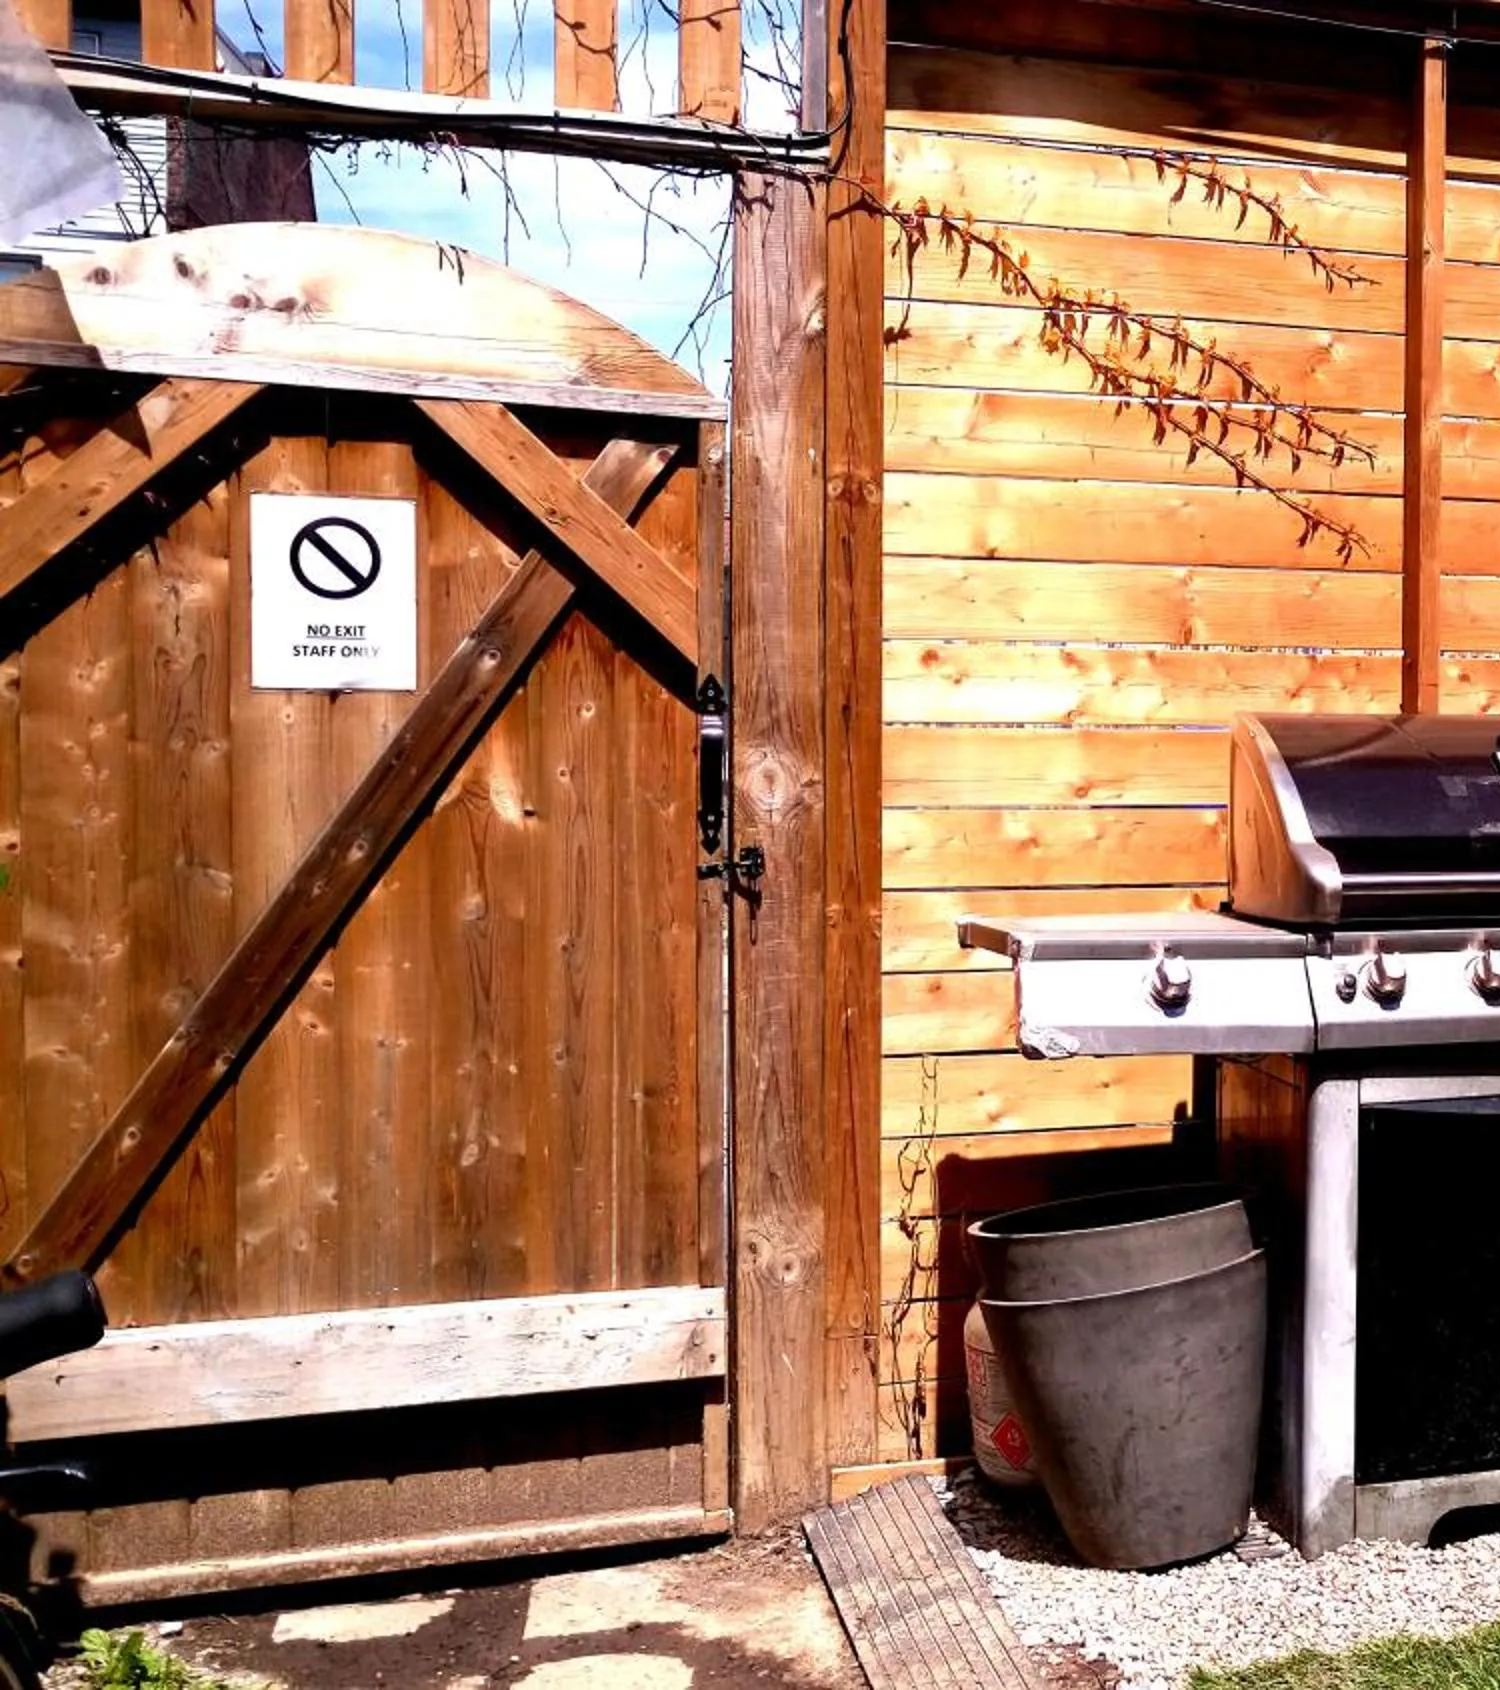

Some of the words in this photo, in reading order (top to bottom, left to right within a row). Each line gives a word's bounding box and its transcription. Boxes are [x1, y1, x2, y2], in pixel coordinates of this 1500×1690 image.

[307, 623, 331, 637] NO
[334, 625, 366, 637] EXIT
[292, 645, 336, 657] STAFF
